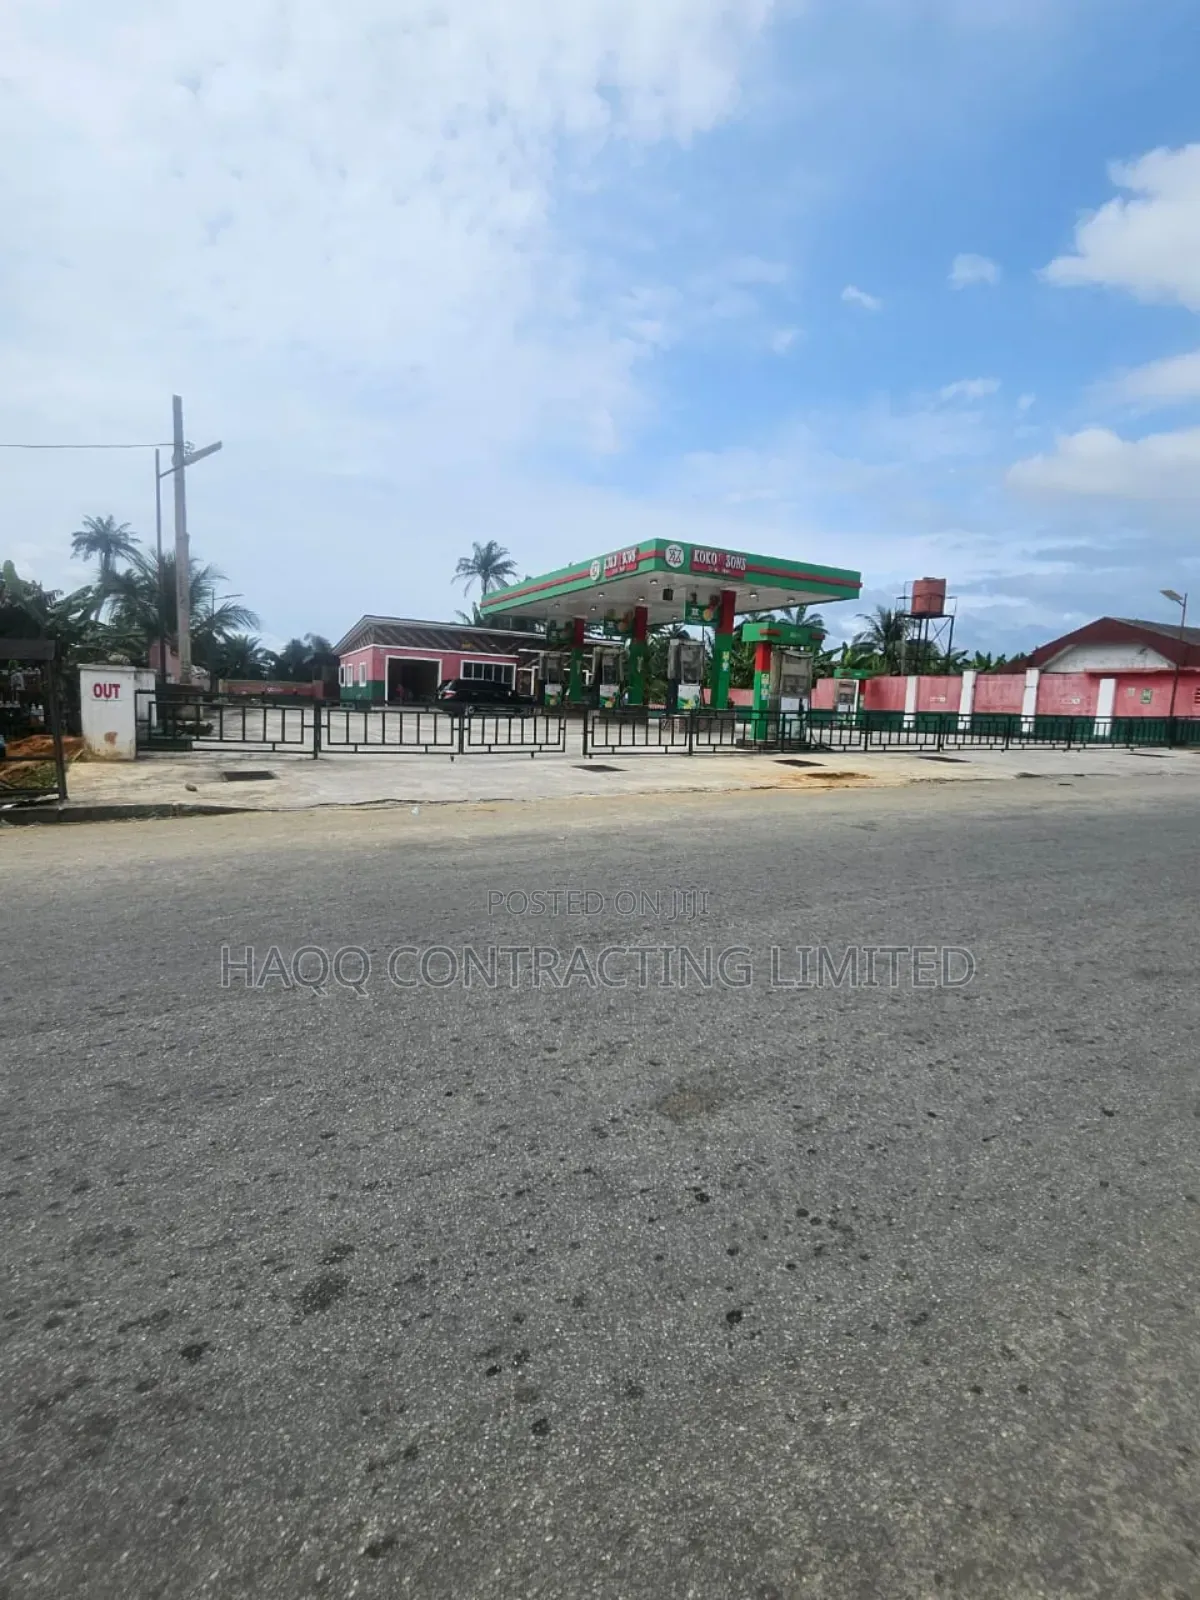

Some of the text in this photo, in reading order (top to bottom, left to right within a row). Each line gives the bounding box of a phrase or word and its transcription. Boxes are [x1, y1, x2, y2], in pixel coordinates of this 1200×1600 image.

[693, 549, 717, 566] KOKO
[725, 554, 747, 571] SONS
[93, 683, 120, 699] OUT
